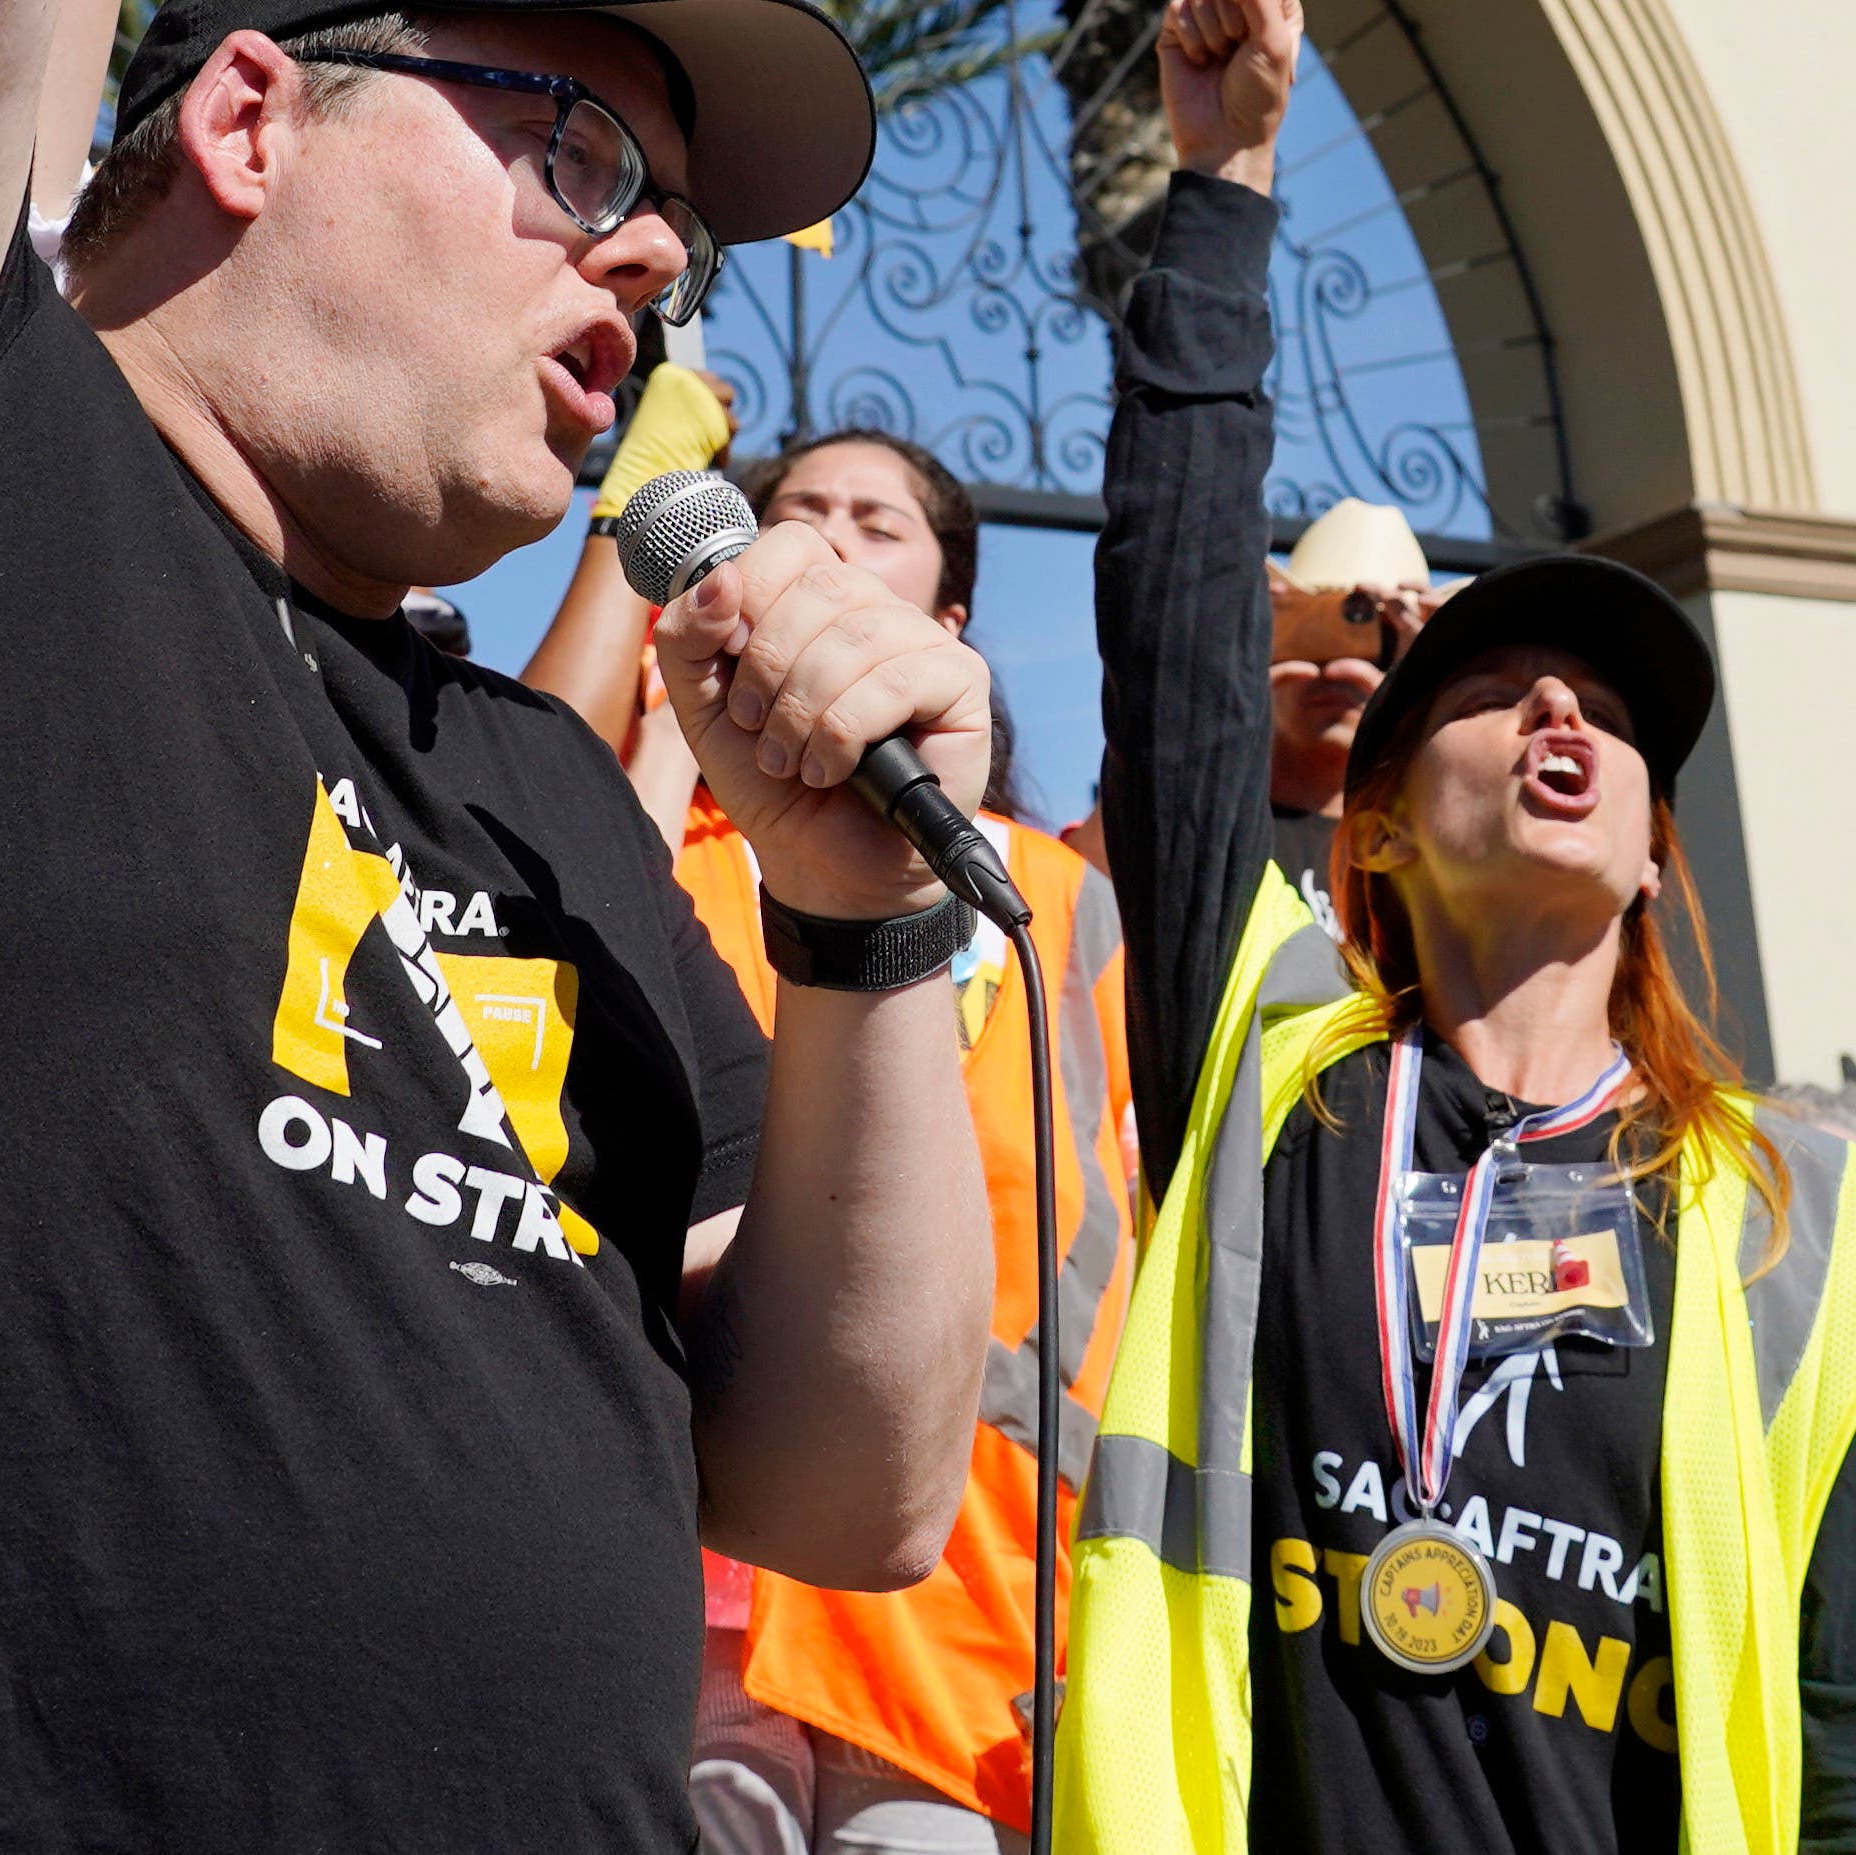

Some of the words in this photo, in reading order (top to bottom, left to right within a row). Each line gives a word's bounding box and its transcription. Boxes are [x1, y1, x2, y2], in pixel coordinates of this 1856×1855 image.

[482, 1006, 533, 1023] PAUSE
[257, 1095, 388, 1200] ON
[405, 1151, 585, 1269] STR
